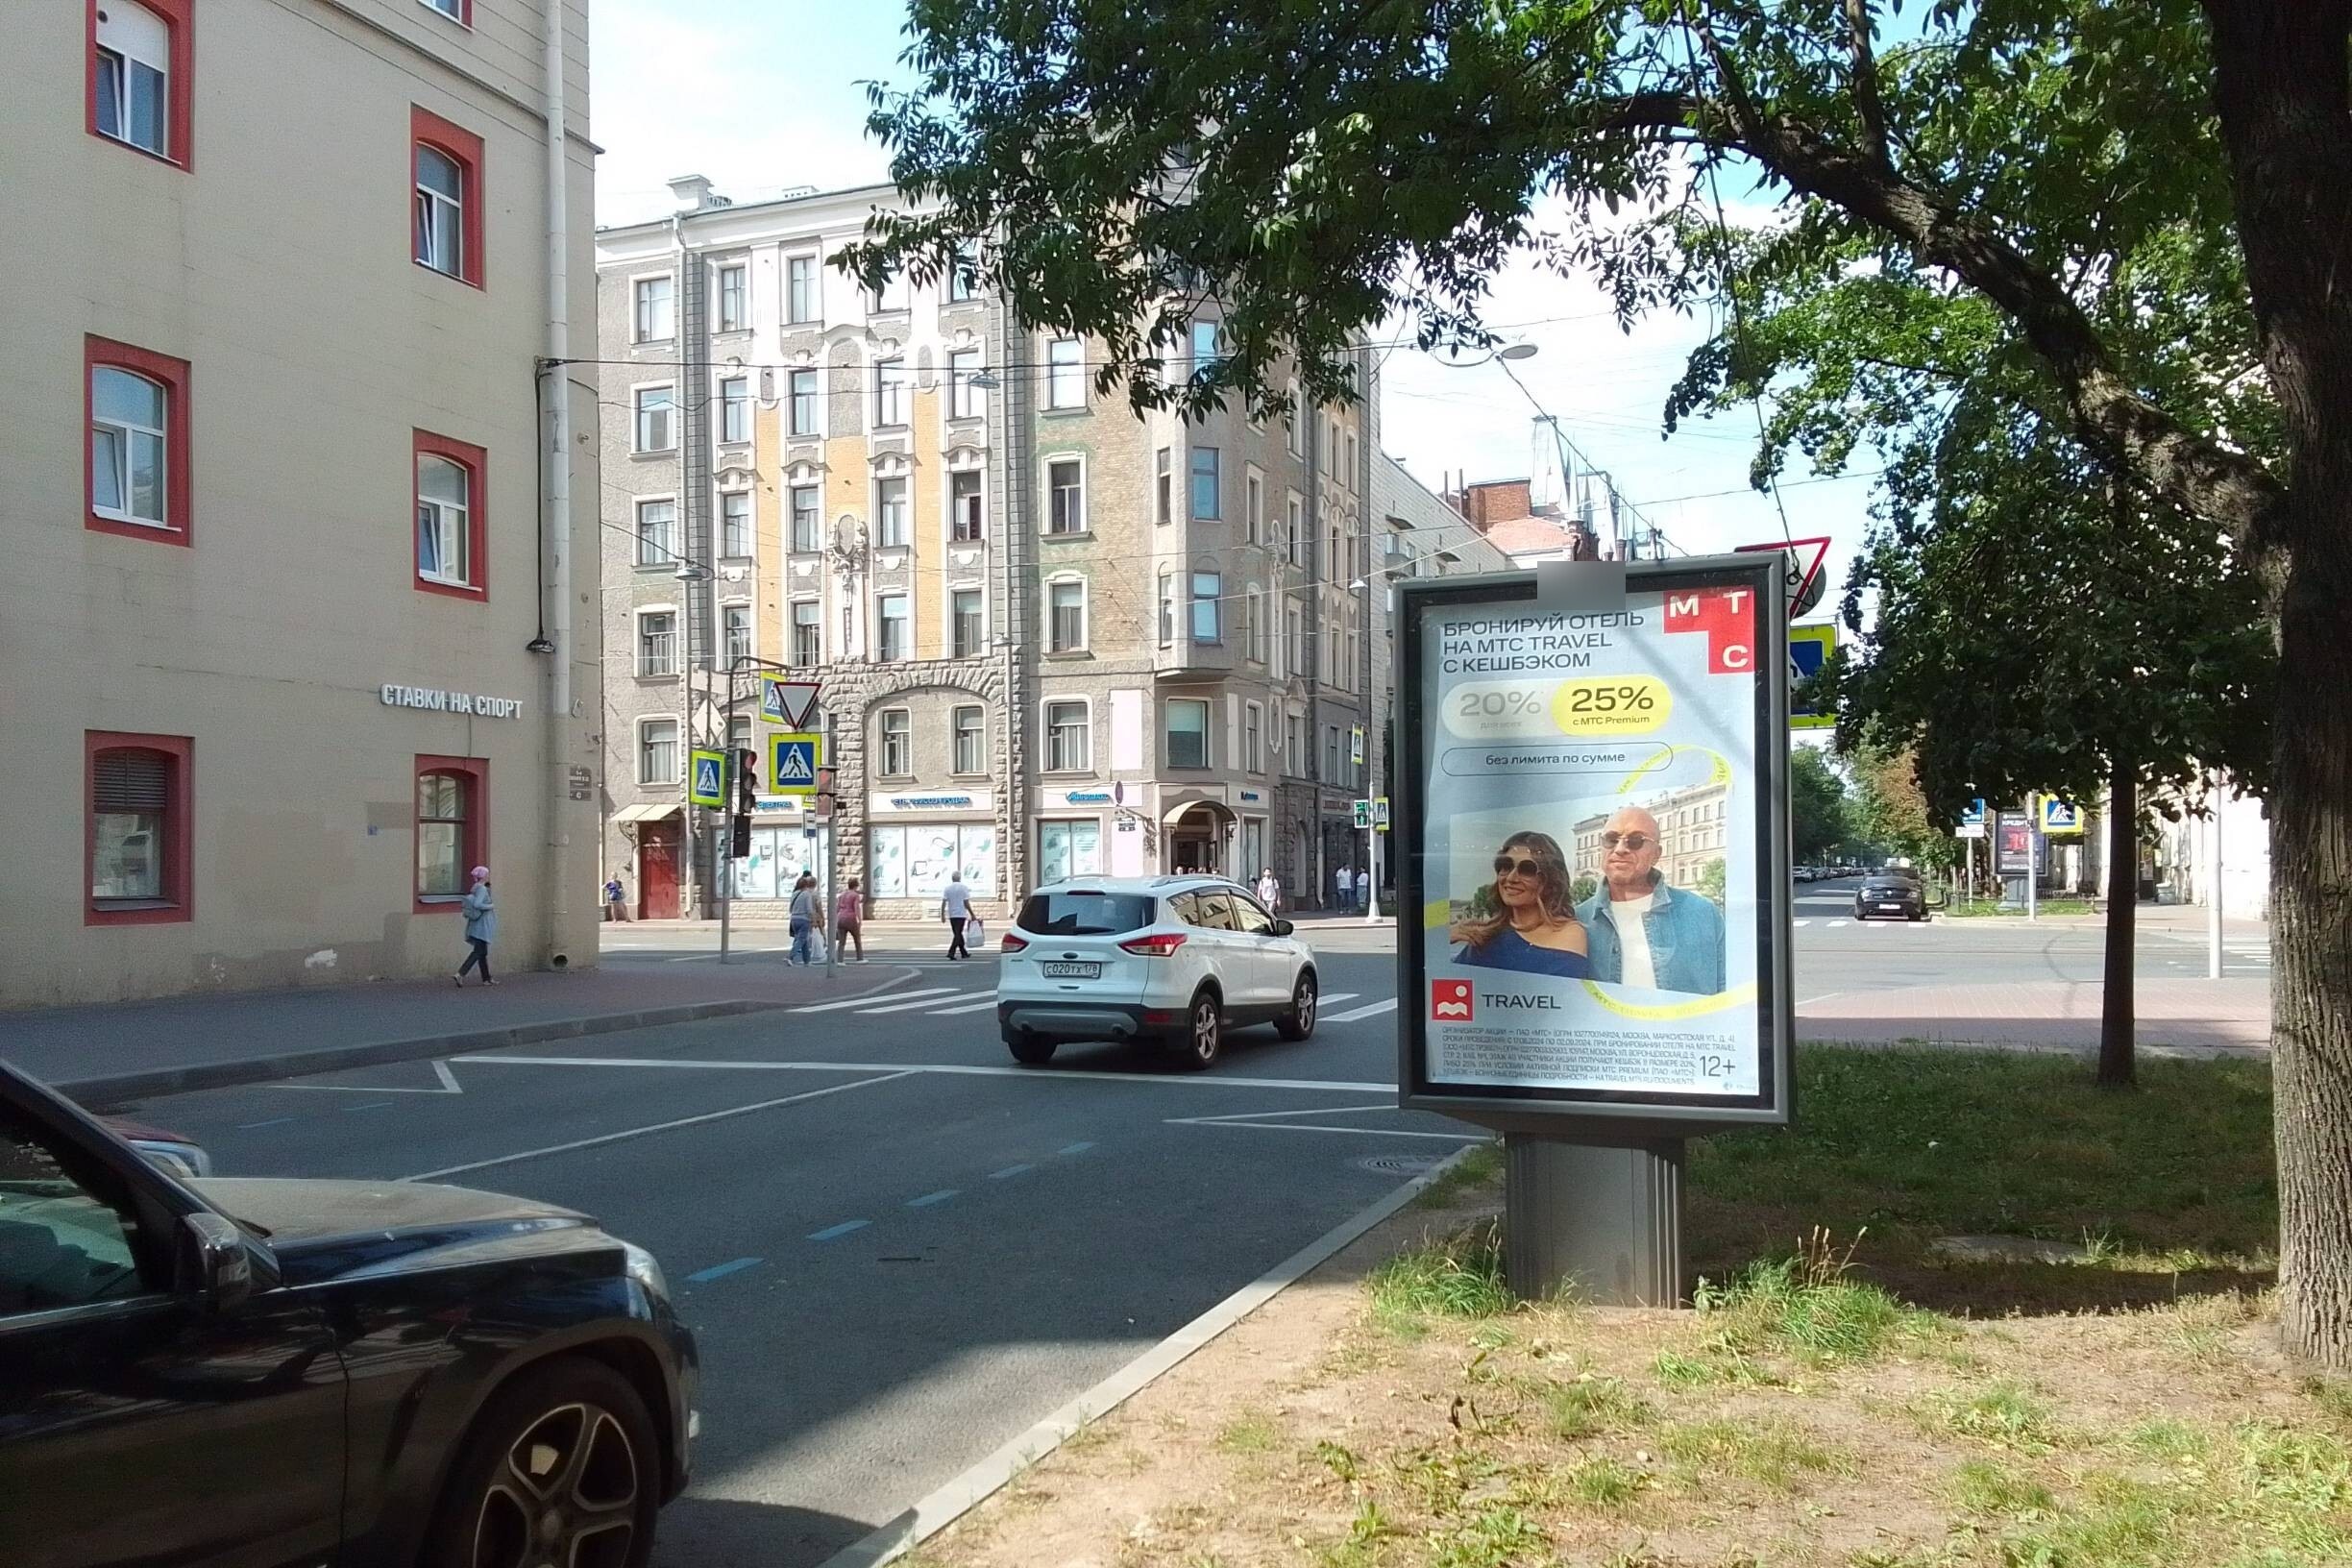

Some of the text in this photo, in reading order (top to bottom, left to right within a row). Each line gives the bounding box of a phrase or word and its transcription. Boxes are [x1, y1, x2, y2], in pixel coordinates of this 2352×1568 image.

[1443, 611, 1645, 637] БРОНИРУЙ ОТЕЛЬ
[1443, 633, 1613, 655] НА МТС TRAVEL
[1443, 652, 1591, 674] С КЕШБЭКОМ
[380, 683, 524, 720] СТАВКИ НА СПОРТ
[1459, 690, 1541, 717] 20%
[1571, 685, 1654, 713] 25%
[1580, 717, 1604, 726] МТС
[1605, 715, 1650, 725] Premium
[1485, 753, 1508, 766] без
[1511, 754, 1559, 766] лимита
[1563, 754, 1578, 765] по
[1581, 754, 1626, 767] сумме
[1481, 992, 1562, 1011] TRAVEL
[1699, 1054, 1737, 1078] 12+
